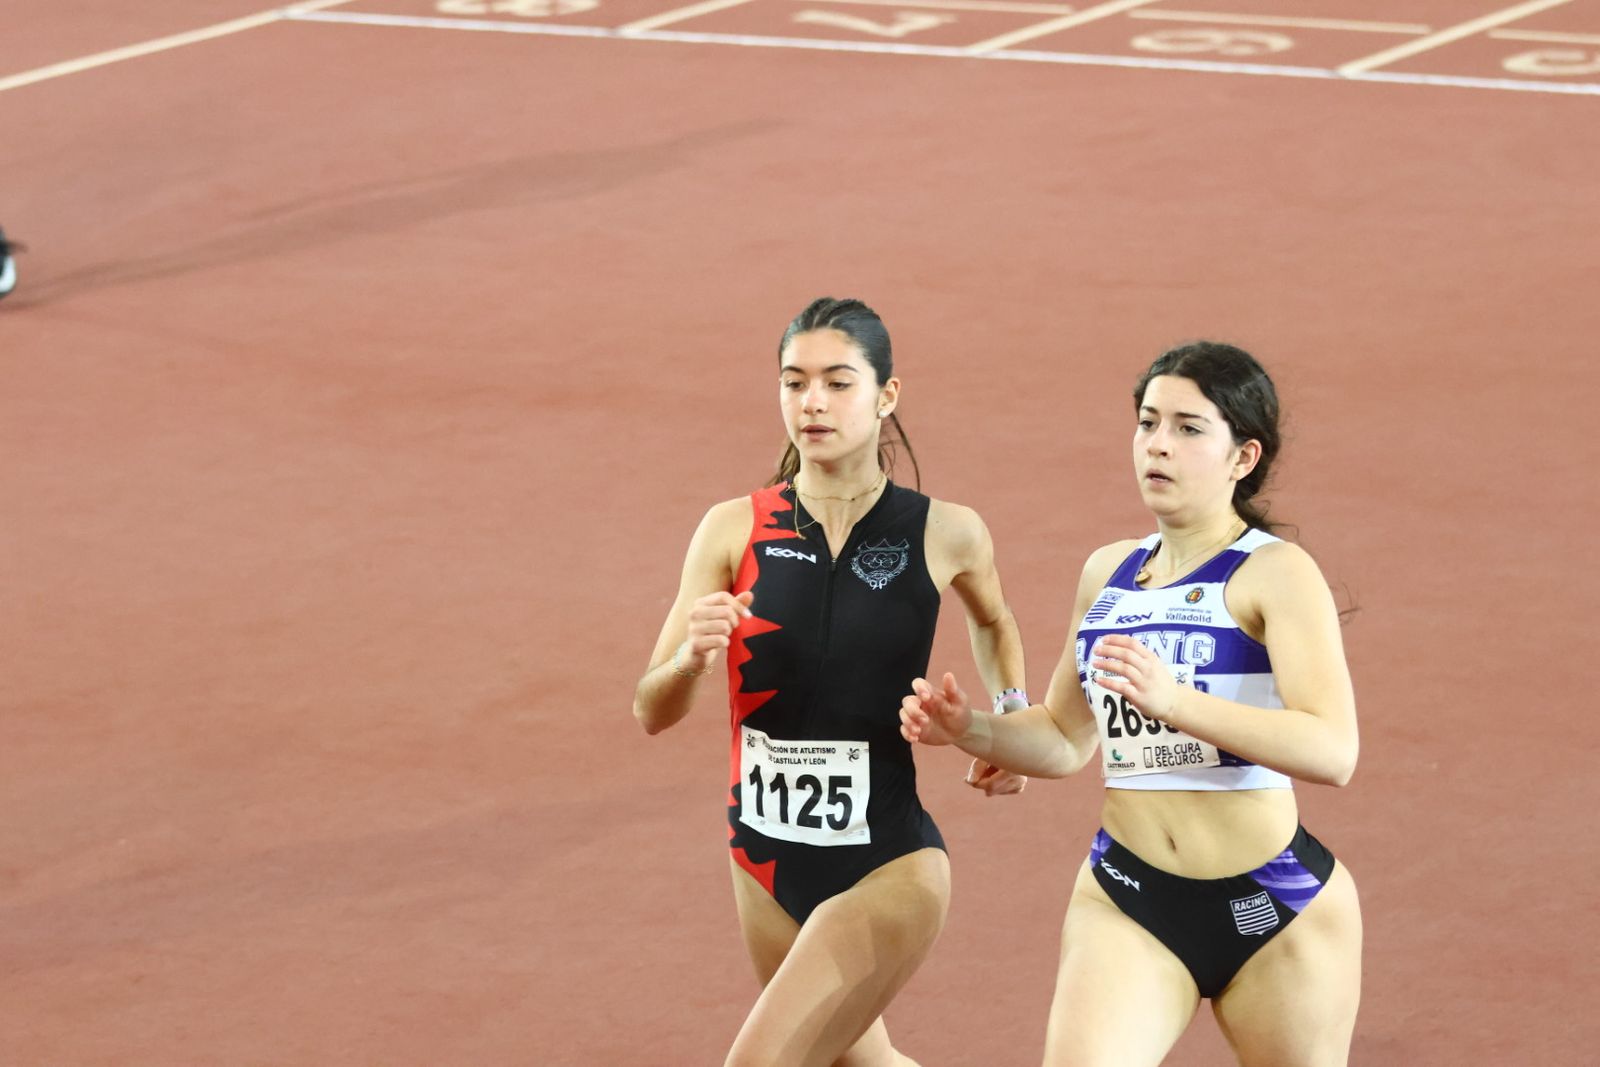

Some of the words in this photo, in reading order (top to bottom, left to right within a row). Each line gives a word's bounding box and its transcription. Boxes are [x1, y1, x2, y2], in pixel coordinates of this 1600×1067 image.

[794, 10, 958, 37] 7
[1165, 612, 1212, 623] Valladolid
[1154, 745, 1172, 757] DEL
[1173, 742, 1202, 755] CURA
[1155, 752, 1205, 768] SEGUROS
[749, 764, 853, 831] 1125
[1233, 894, 1268, 912] RACING
